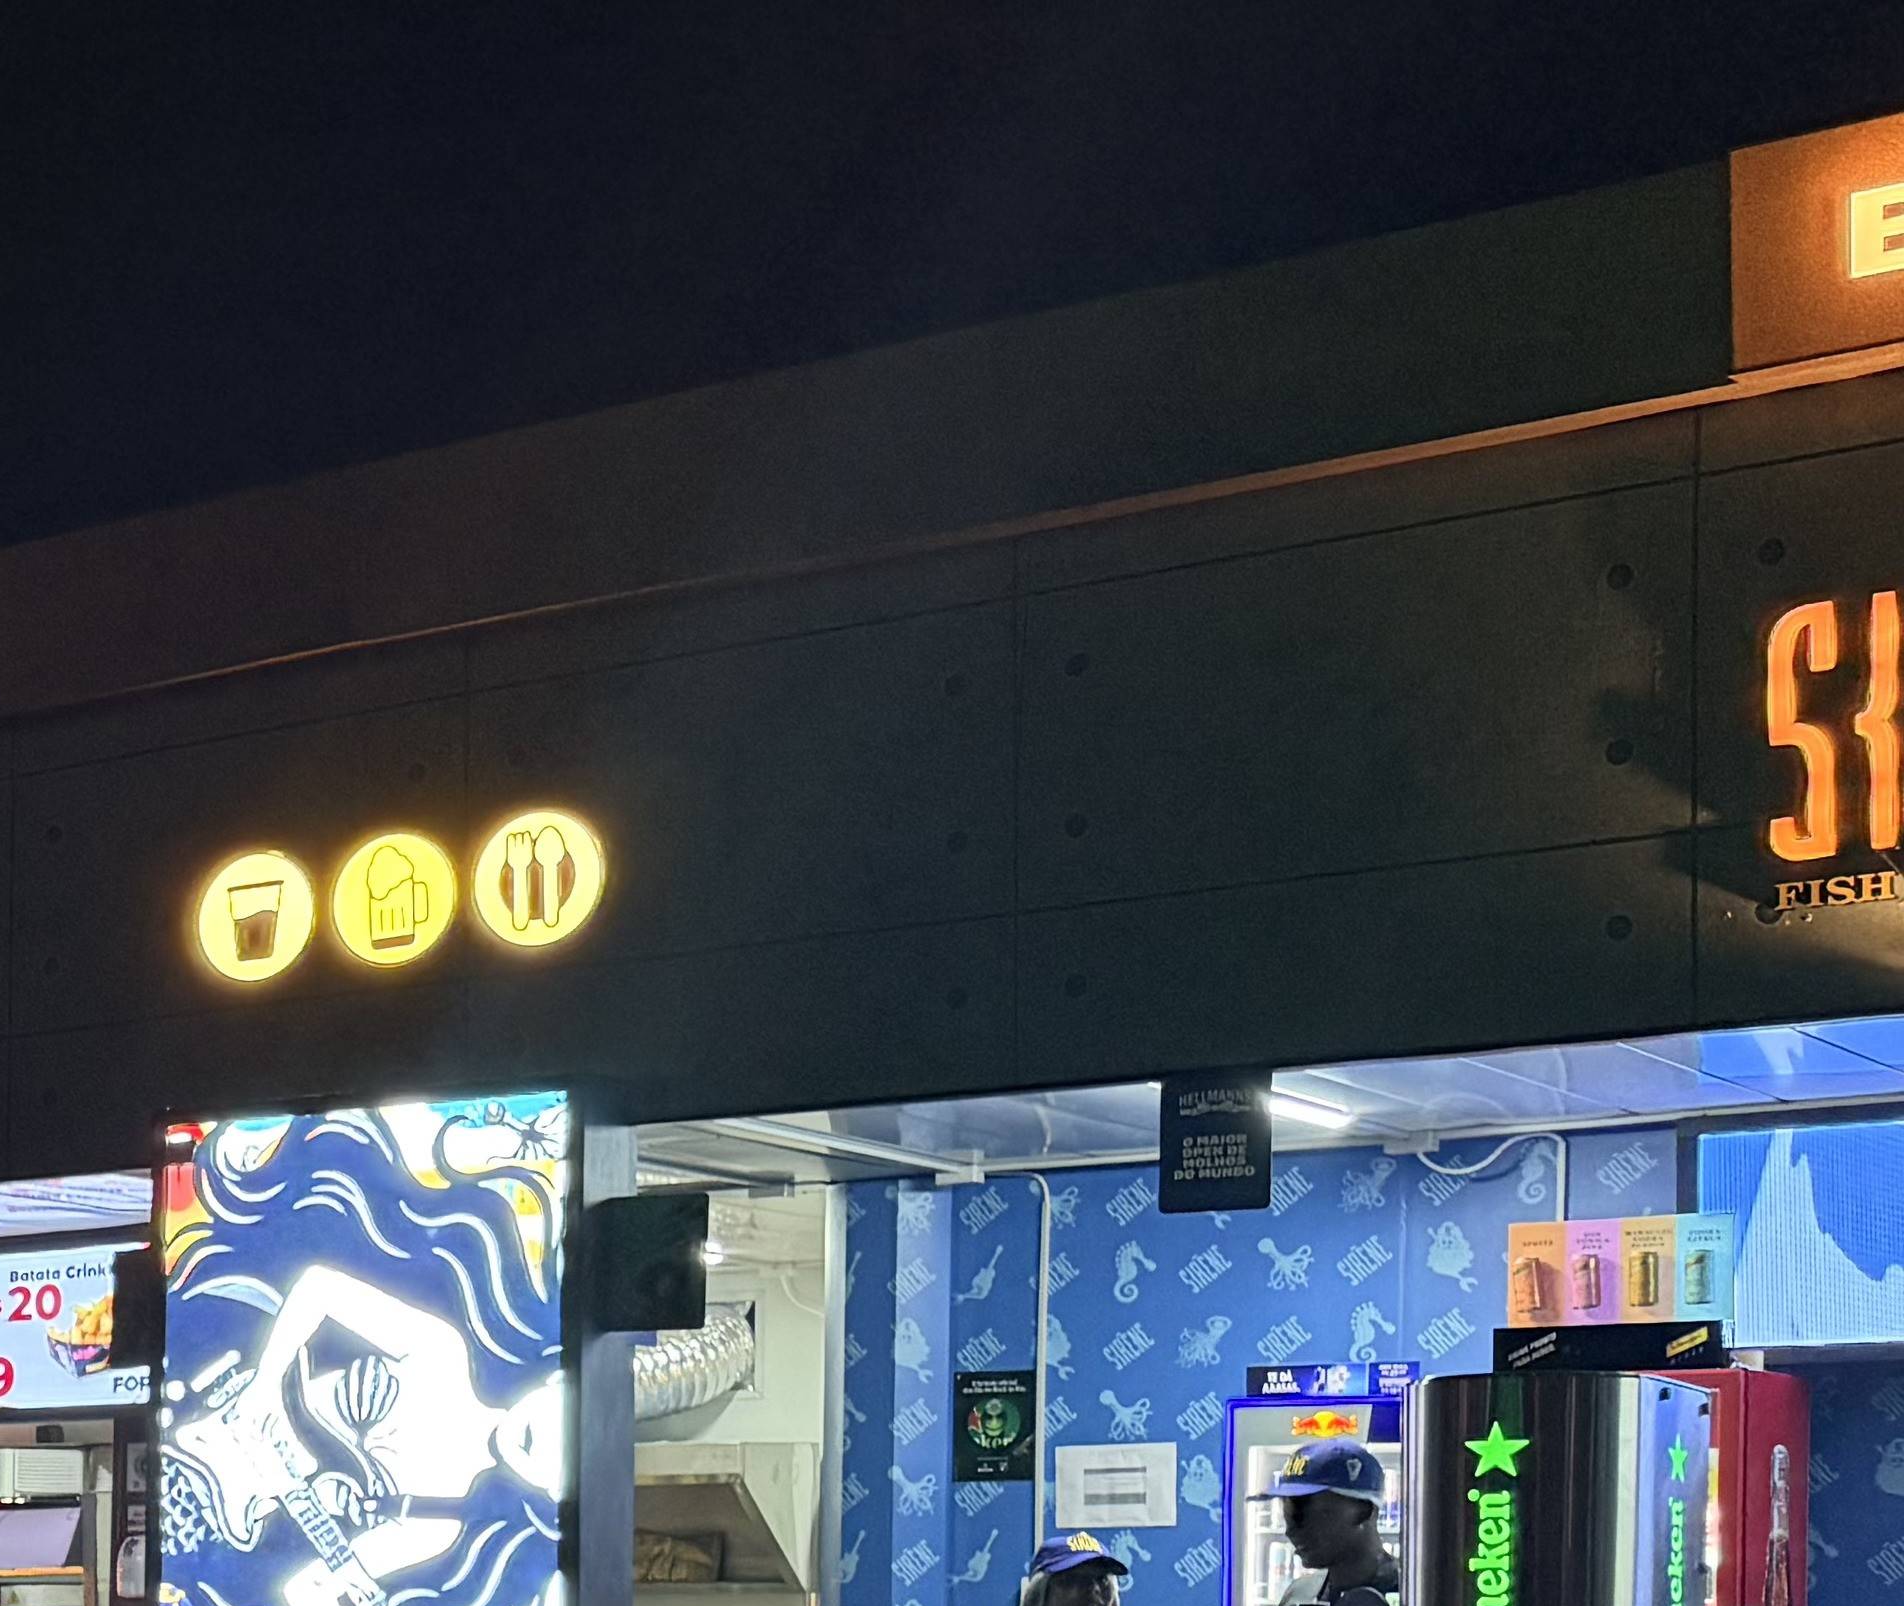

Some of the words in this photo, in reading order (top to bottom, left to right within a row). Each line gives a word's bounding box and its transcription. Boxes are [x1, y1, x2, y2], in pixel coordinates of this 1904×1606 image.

[1774, 870, 1898, 911] FISH
[1182, 1146, 1224, 1159] OPEN
[1226, 1145, 1248, 1156] DE
[1196, 1133, 1248, 1147] MAIOR
[1173, 1169, 1196, 1181] DO
[1197, 1165, 1256, 1180] MUNDO
[9, 1269, 61, 1283] Batata
[1178, 1244, 1233, 1293] SIRÈNE
[1337, 1235, 1393, 1287] SIRÈNE
[7, 1283, 63, 1323] 20
[1103, 1322, 1155, 1370] SIRÈNE
[1417, 1307, 1477, 1360] SIRÈNE
